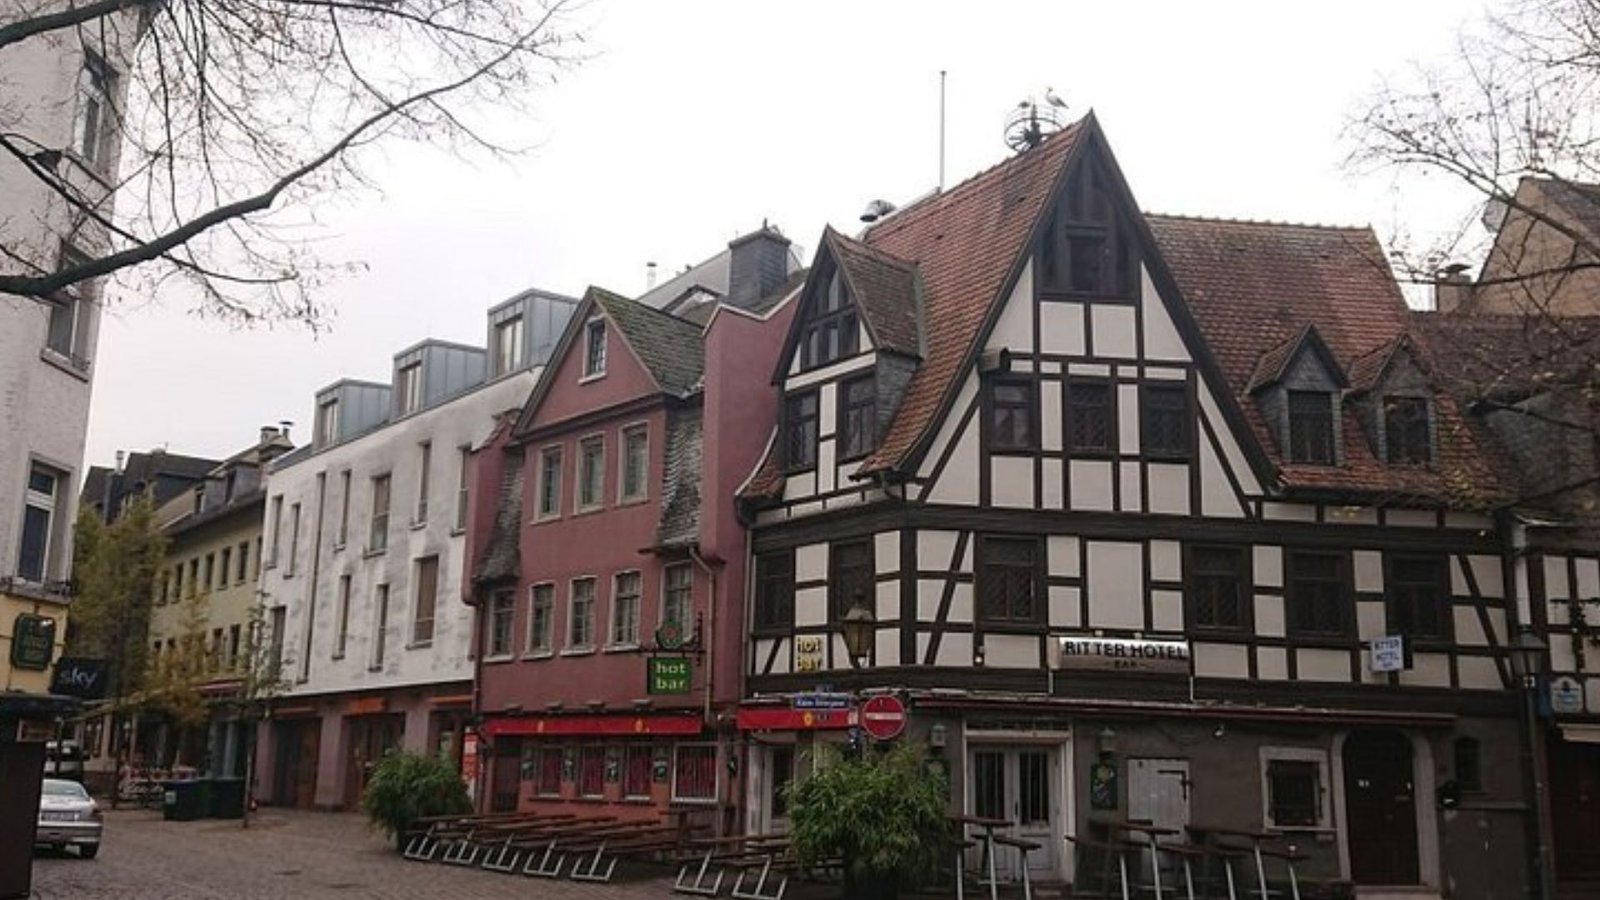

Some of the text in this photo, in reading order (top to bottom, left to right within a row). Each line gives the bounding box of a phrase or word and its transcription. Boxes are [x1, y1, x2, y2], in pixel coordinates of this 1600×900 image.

[1064, 641, 1188, 660] RITTER HOTEL
[655, 661, 687, 674] hot
[61, 667, 98, 689] sky
[655, 677, 686, 689] bar
